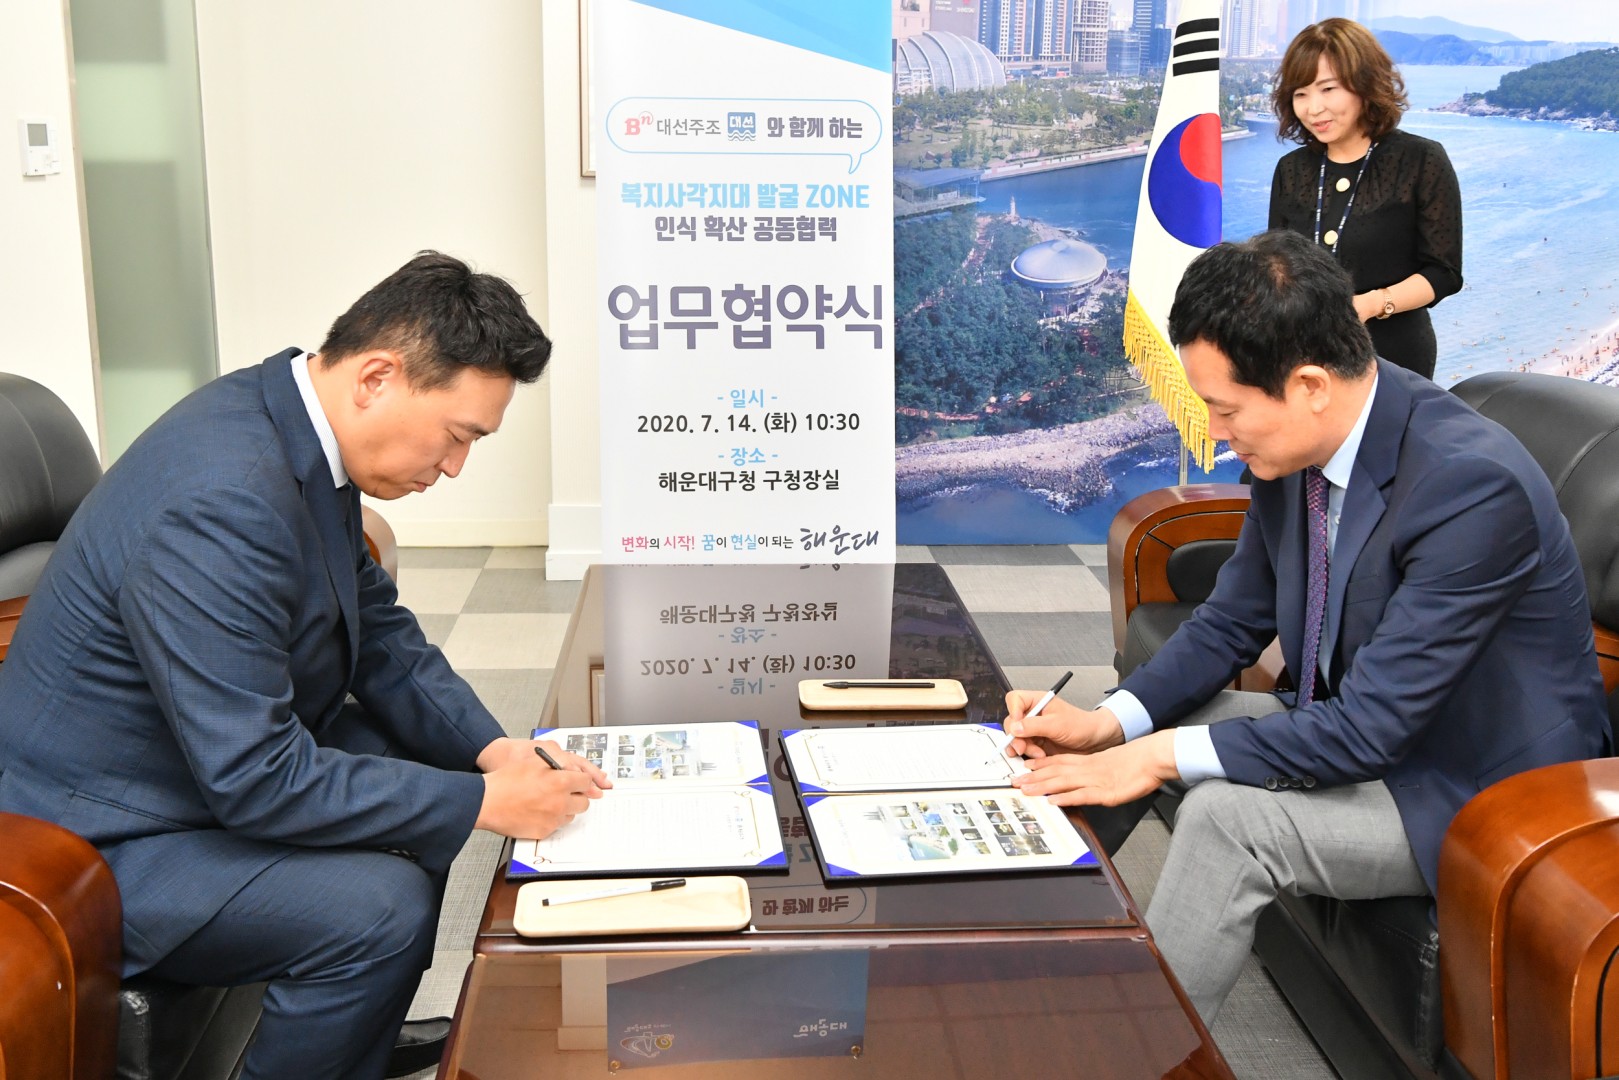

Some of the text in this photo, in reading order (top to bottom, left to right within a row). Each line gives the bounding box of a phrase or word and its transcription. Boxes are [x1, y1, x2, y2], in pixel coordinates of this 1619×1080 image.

[657, 118, 721, 136] 대선주조
[729, 115, 754, 129] 대선
[767, 116, 785, 138] 와
[789, 115, 824, 138] 함께
[829, 117, 862, 139] 하는
[621, 182, 870, 208] 복지사각지대 발굴 ZONE
[655, 215, 837, 242] 인식 확산 공동협력
[608, 283, 883, 350] 업무협약식
[730, 389, 764, 408] 일시
[637, 412, 860, 434] 2020. 7. 14. (화) 10:30
[731, 447, 766, 467] 장소
[658, 469, 839, 492] 해운대구청 구청장실
[621, 524, 879, 556] 변화의 시작! 꿈이 현실이 되는 해운대
